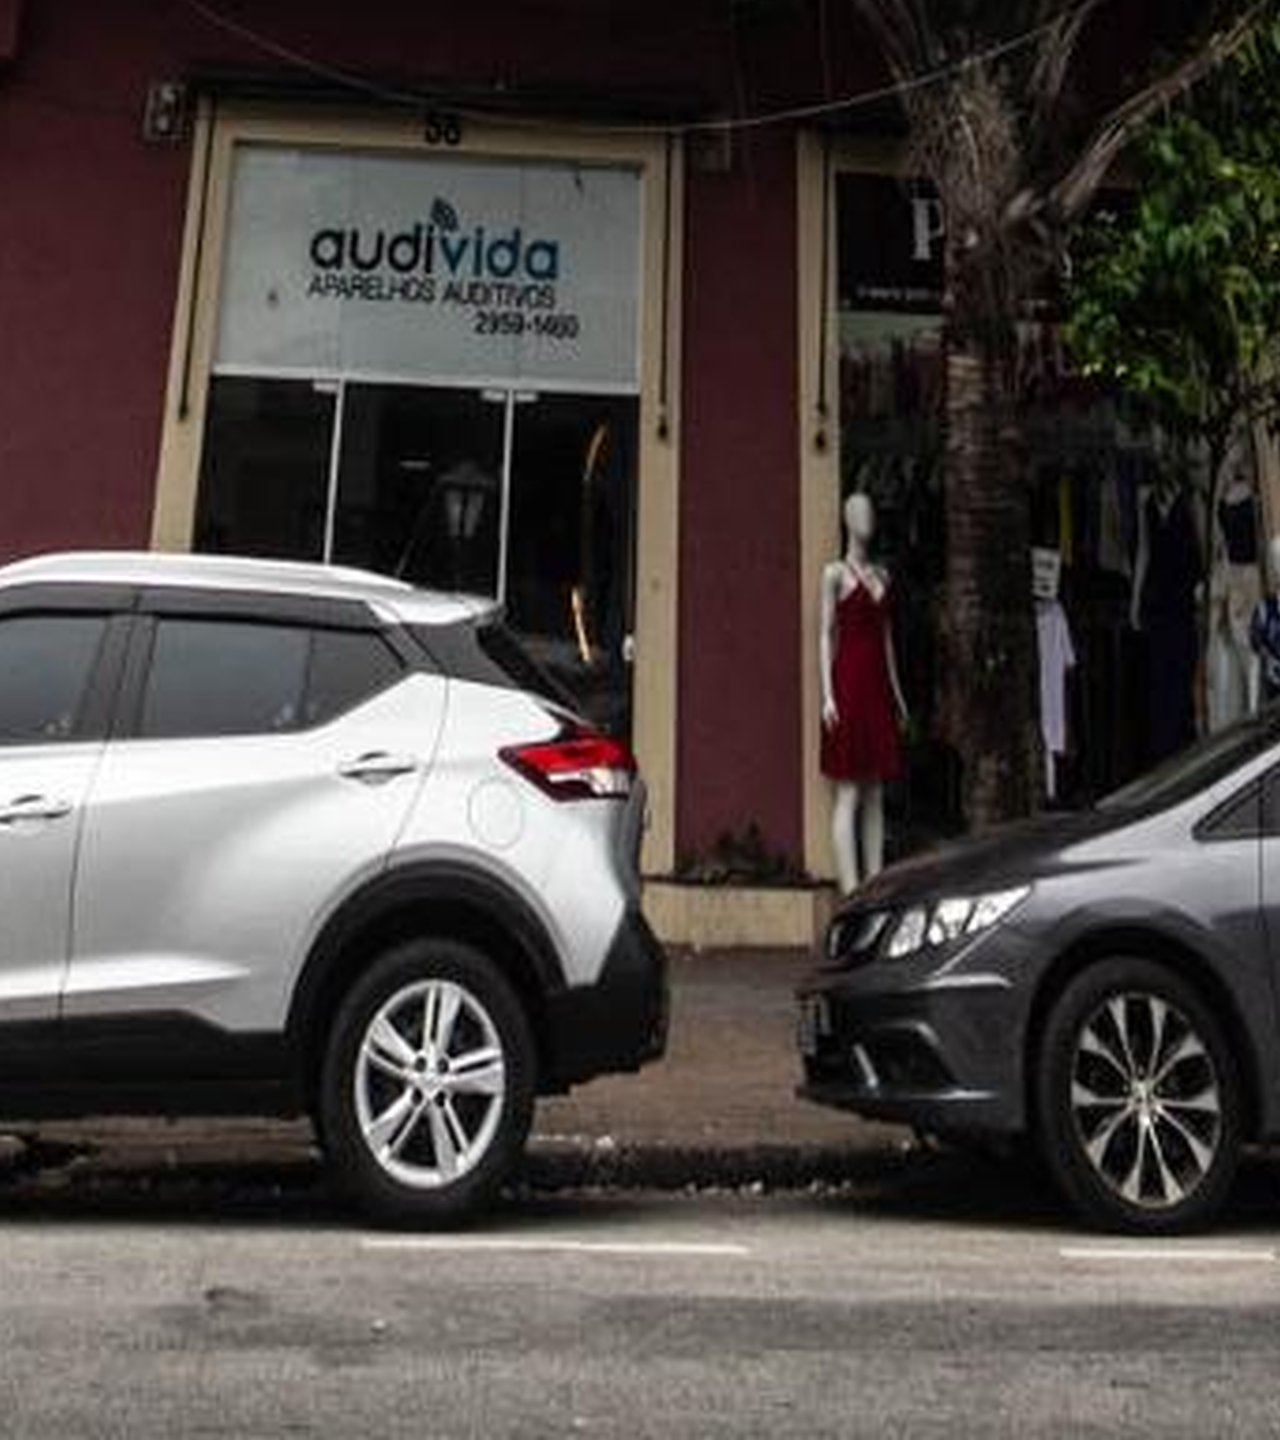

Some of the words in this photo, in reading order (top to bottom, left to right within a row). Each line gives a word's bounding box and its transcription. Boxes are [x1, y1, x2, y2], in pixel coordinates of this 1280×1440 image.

[308, 223, 560, 280] audivida
[307, 274, 436, 303] APARELHOS
[441, 281, 557, 310] AUDITIVOS
